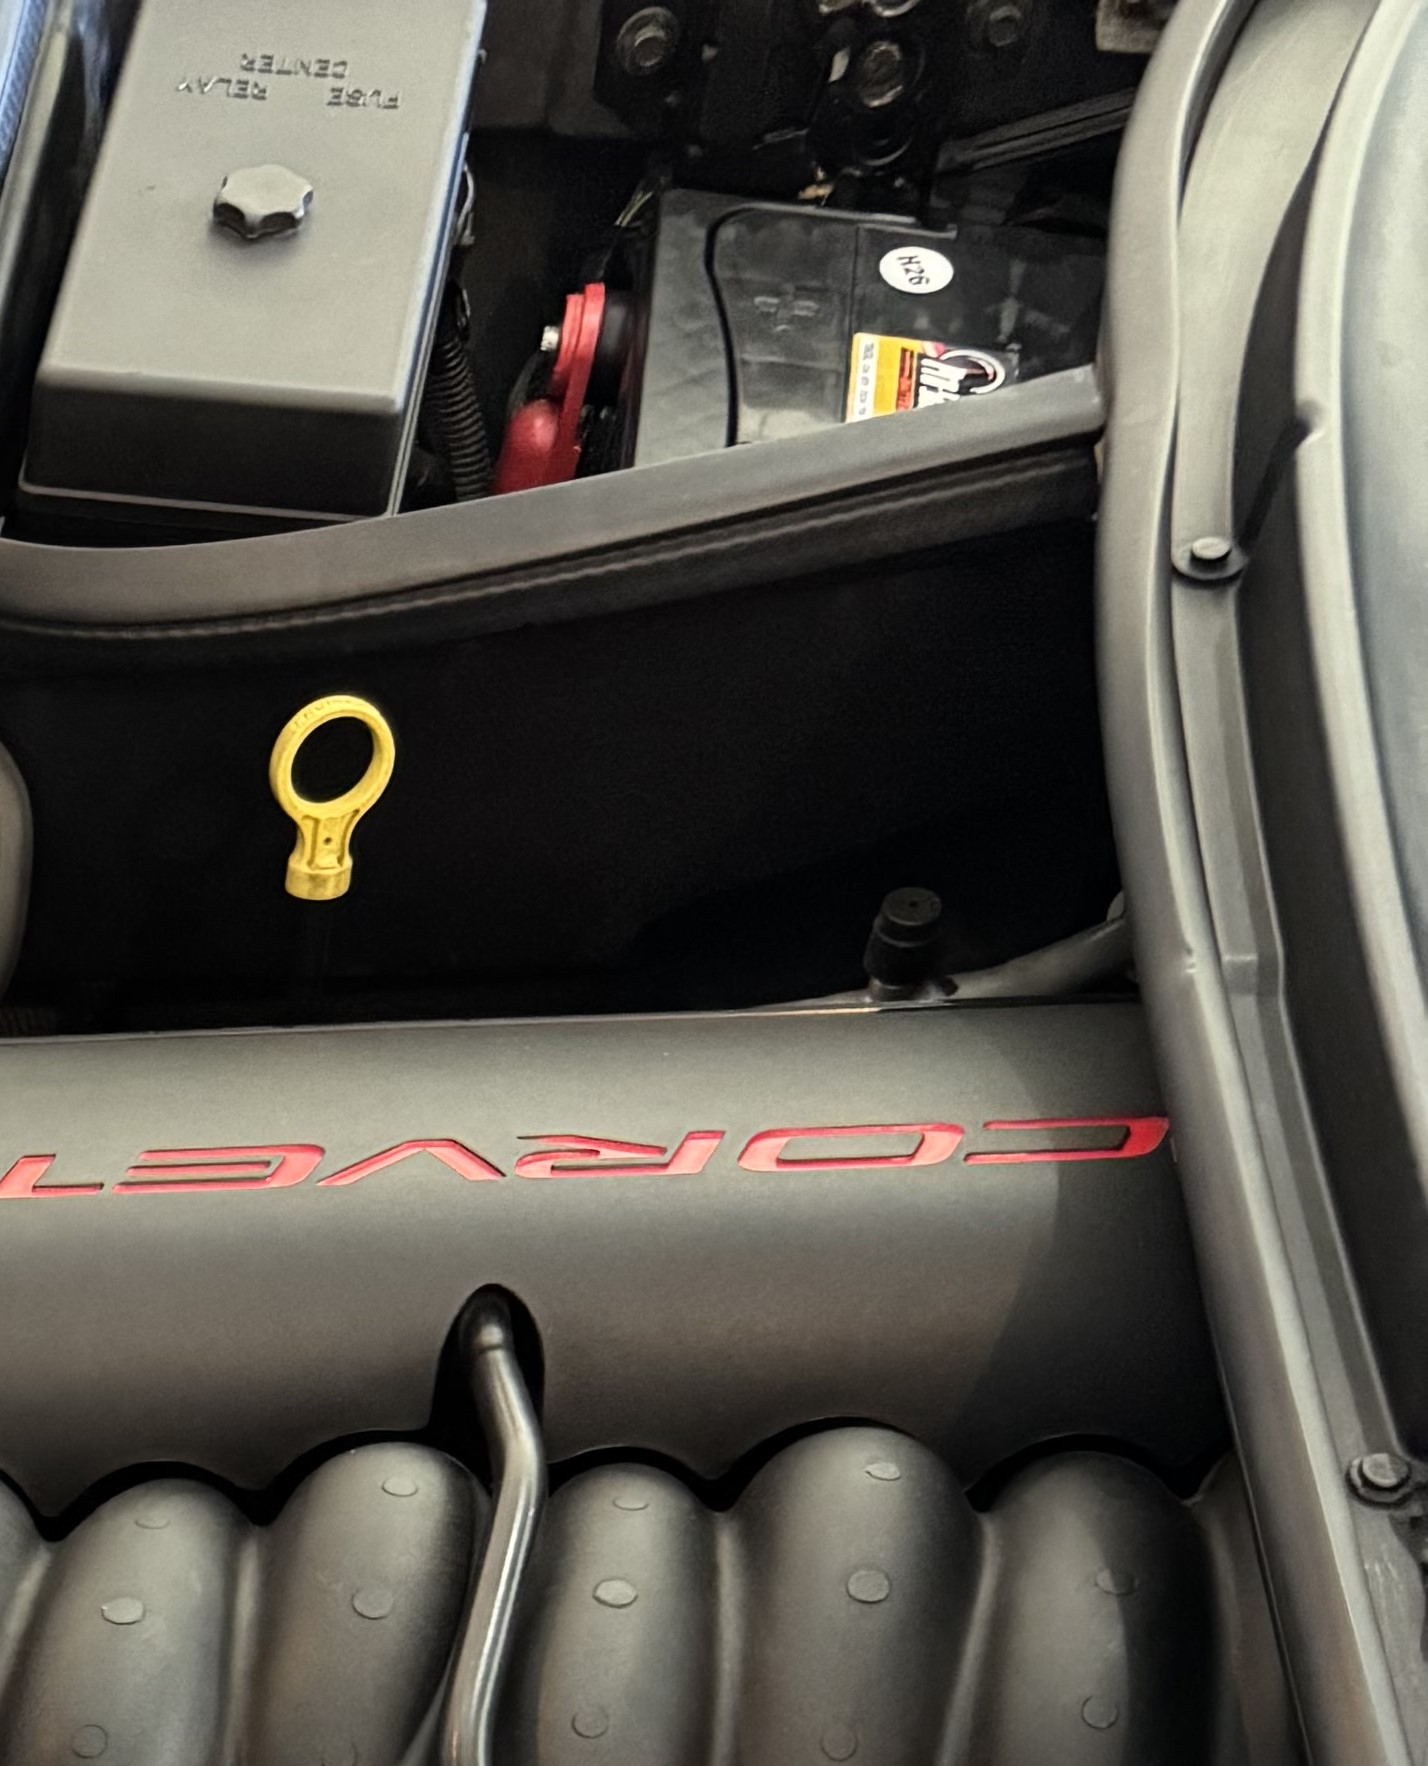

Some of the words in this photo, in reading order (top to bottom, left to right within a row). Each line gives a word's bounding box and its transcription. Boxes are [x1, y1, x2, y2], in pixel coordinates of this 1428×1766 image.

[240, 53, 348, 78] CENTER
[176, 77, 268, 101] RELAY
[327, 86, 400, 111] FUSE
[895, 254, 931, 288] H26
